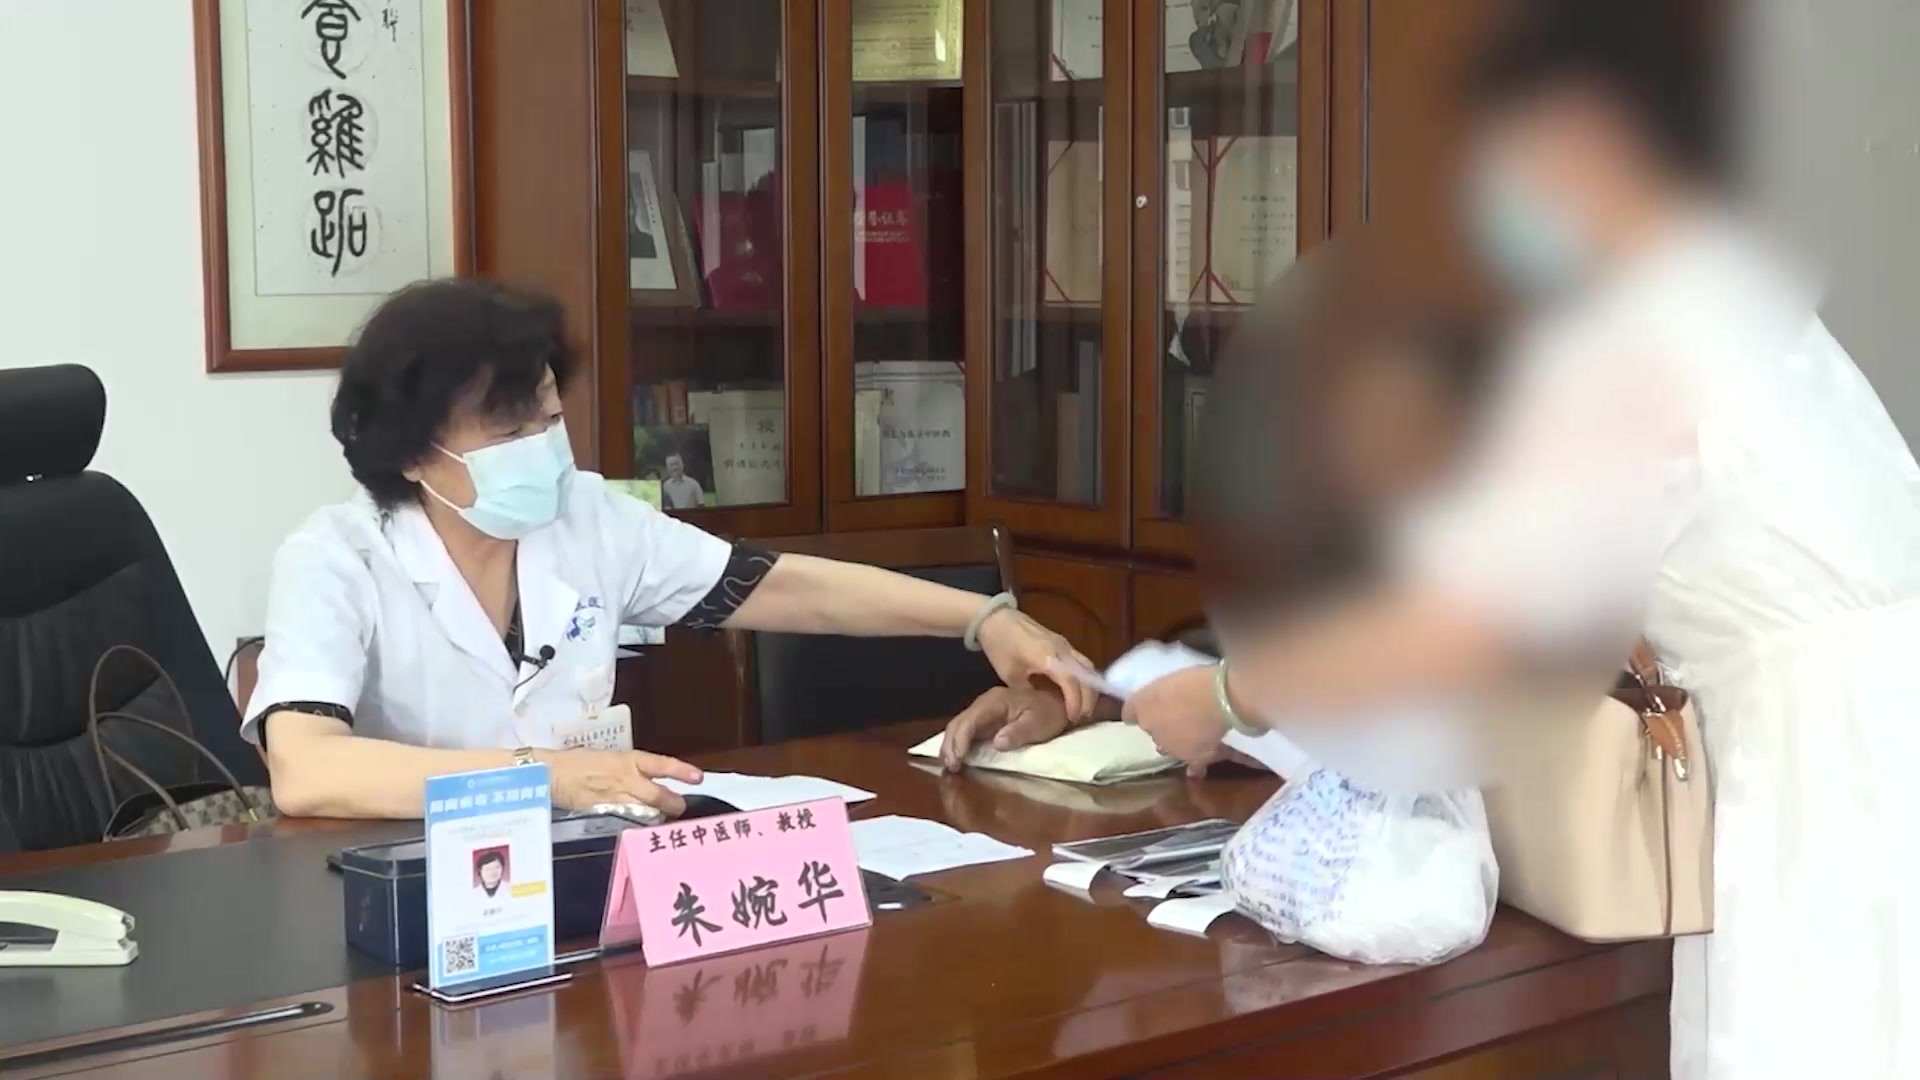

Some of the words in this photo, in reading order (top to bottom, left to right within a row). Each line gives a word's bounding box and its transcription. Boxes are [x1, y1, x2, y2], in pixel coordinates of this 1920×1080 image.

[649, 808, 817, 853] 主任中医师、教授
[671, 860, 844, 947] 朱婉华
